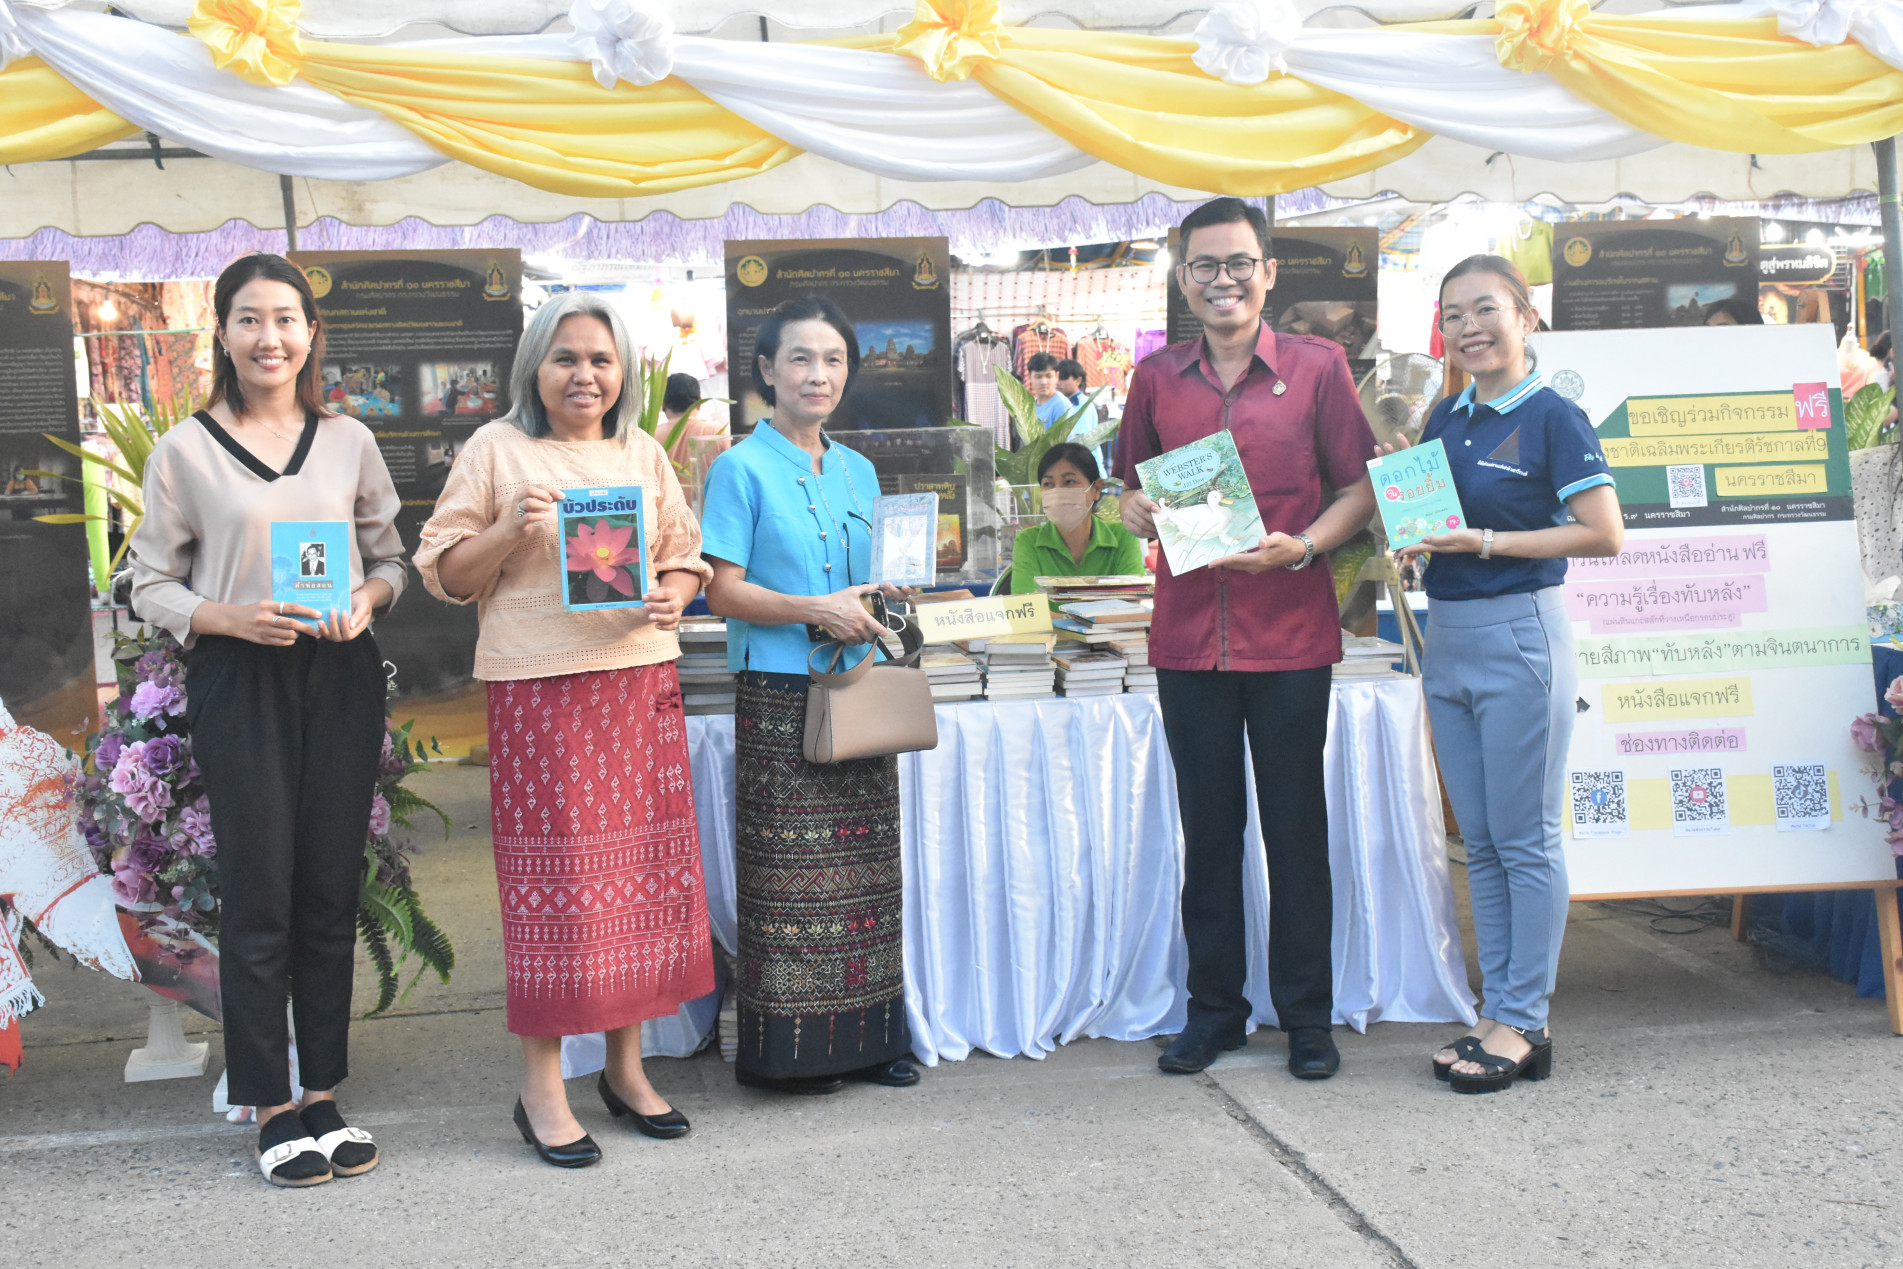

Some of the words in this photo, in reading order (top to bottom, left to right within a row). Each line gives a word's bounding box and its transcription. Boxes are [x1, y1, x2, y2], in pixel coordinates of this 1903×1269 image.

[776, 264, 836, 279] สำนักศิลปากรที่
[853, 266, 900, 278] นครราชสีมา
[341, 277, 404, 290] สำนักศิลปากรที่
[421, 279, 471, 289] นครราชสีมา
[1628, 402, 1789, 427] ขอเชิญร่วมกิจกรรม
[1795, 389, 1829, 418] ฟรี
[1162, 452, 1213, 477] WEBSTER'S
[1177, 465, 1205, 480] WALK
[1379, 450, 1441, 487] ดอกไม้
[1725, 469, 1817, 487] นครราชสีมา
[562, 496, 638, 514] บัวประดับ
[1644, 509, 1691, 519] นครราชสีมา
[1786, 502, 1826, 511] นครราชสีมา
[1743, 540, 1767, 560] ฟรี
[1576, 579, 1751, 612] “ความรู้เรื่องทับหลัง”
[934, 602, 1035, 627] หนังสือแจกฟรี
[1575, 637, 1861, 665] ายสีภาพ“ทับหลัง”ตามจินตนาการ
[1616, 683, 1740, 710] หนังสือแจกฟรี
[1620, 729, 1739, 753] ช่องทางติดต่อ
